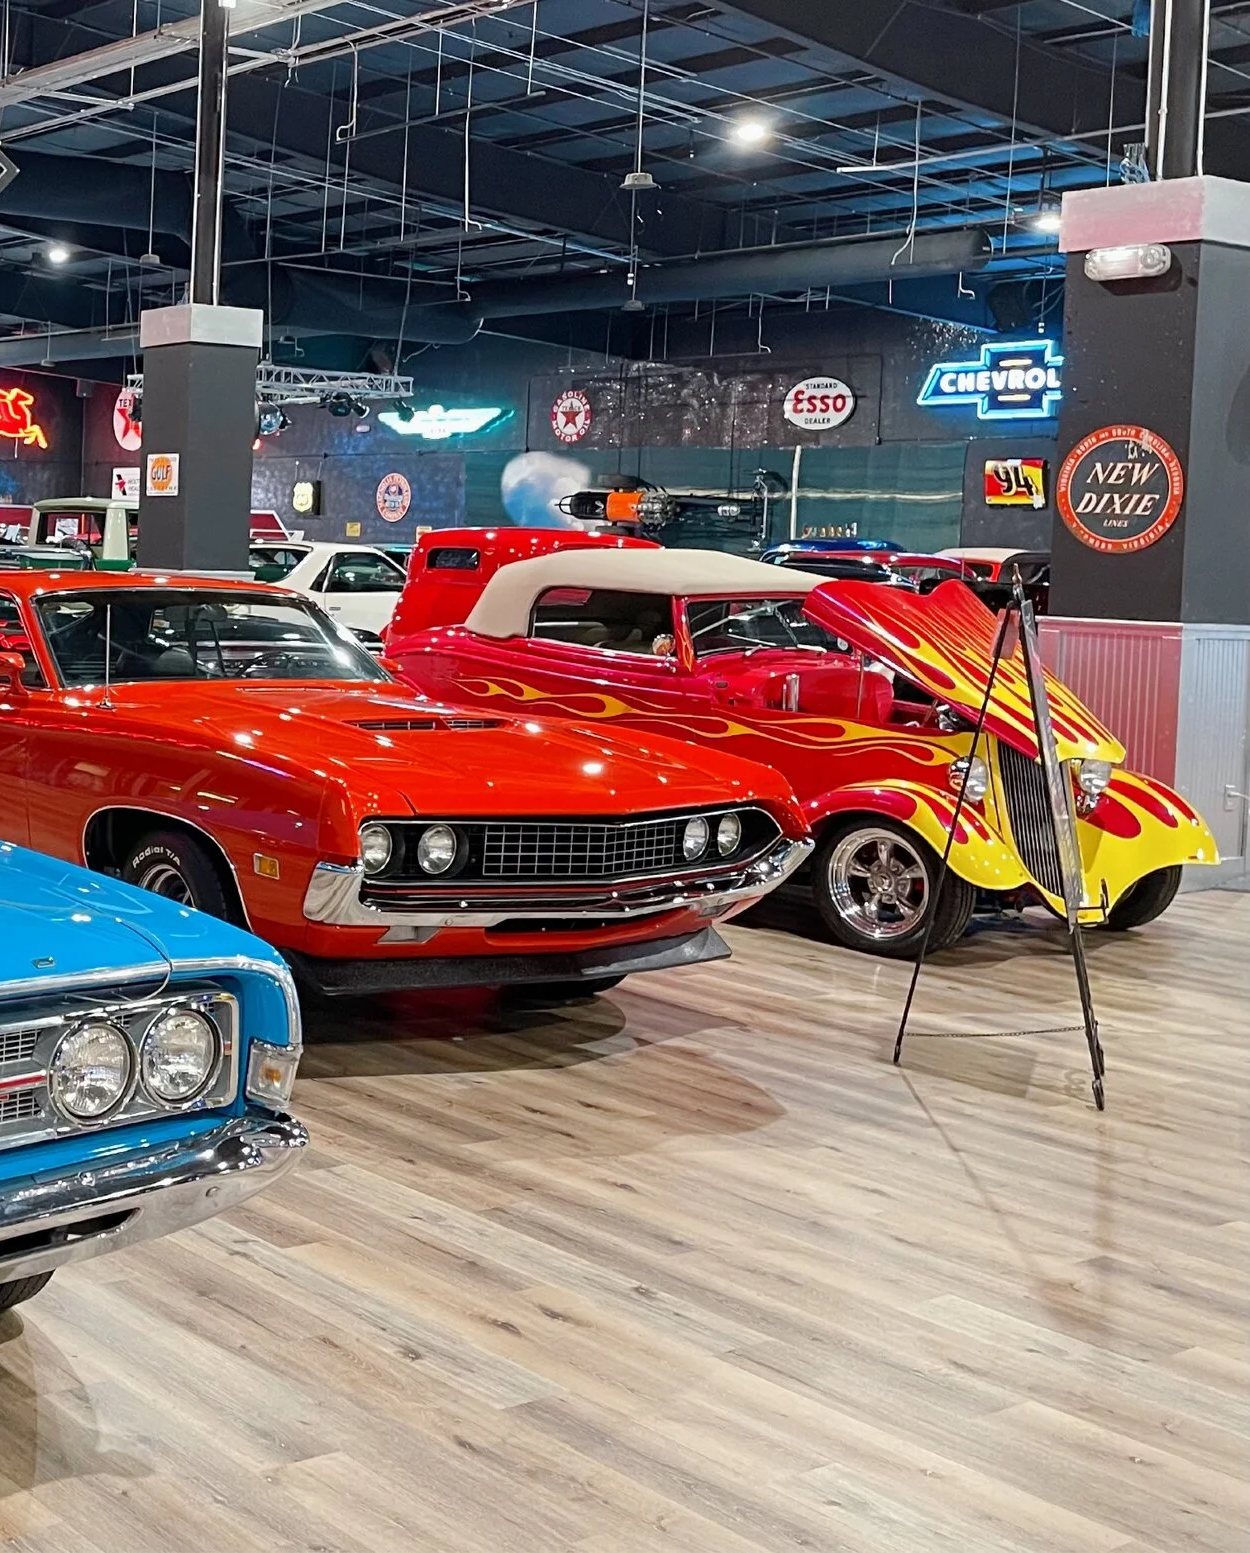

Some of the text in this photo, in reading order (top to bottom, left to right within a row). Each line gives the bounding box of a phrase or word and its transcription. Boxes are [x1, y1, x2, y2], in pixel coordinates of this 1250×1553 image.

[940, 367, 1062, 393] CHEVROL
[151, 465, 171, 480] GULF
[992, 463, 1036, 497] 94
[1086, 462, 1160, 486] NEW
[1075, 493, 1160, 516] DIXIE
[132, 846, 181, 869] Radial T/A
